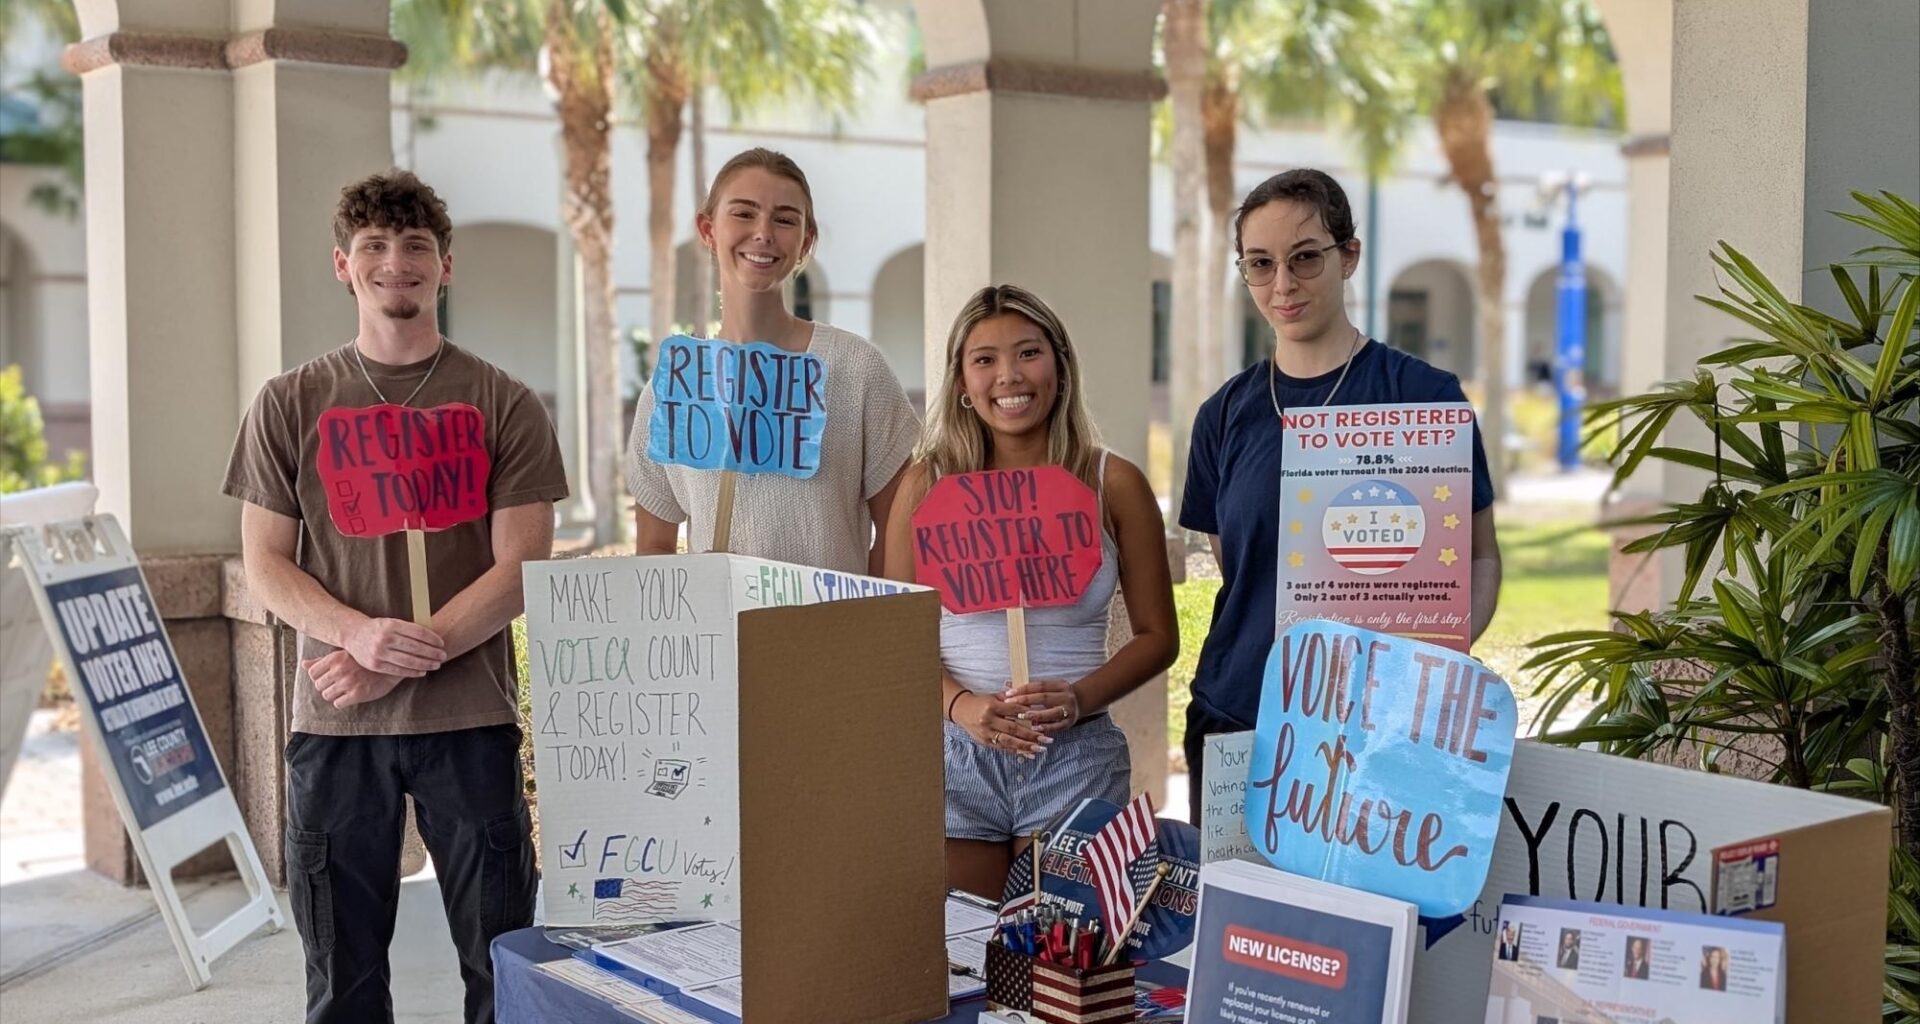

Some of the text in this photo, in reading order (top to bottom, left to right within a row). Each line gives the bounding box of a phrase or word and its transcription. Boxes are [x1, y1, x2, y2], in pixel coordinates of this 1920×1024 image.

[669, 345, 826, 413] REGISTER
[663, 401, 813, 470] TO VOTE
[1282, 409, 1473, 429] NOT REGISTERED
[1299, 429, 1456, 449] TO VOTE YET?
[328, 409, 482, 470] REGISTER
[1356, 454, 1394, 465] 78.8%
[372, 457, 477, 517] TODAY!
[1315, 469, 1338, 477] voter
[1341, 468, 1375, 476] turnout
[1389, 467, 1403, 475] the
[1405, 466, 1430, 474] 2024
[1432, 465, 1472, 474] election.
[957, 470, 1038, 516] STOP!
[1343, 529, 1405, 543] VOTED
[1370, 511, 1378, 524] I
[916, 511, 1094, 565] REGISTER TO
[549, 567, 697, 624] MAKE YOUR
[813, 571, 911, 603] STUDE
[942, 554, 1078, 607] VOTE HERE
[1286, 580, 1460, 590] 3 out of 4 voters were registered.
[1294, 592, 1451, 602] Only 2 out of 3 actually voted.
[57, 584, 156, 654] UPDATE
[1354, 614, 1364, 624] is
[1367, 612, 1392, 628] only
[1396, 612, 1412, 624] the
[1412, 611, 1437, 629] first
[1440, 611, 1470, 628] step!
[81, 639, 174, 703] VOTER INFO
[648, 633, 723, 682] COUNT
[541, 691, 707, 739] & REGISTER
[1283, 632, 1500, 763] VOICE THE
[546, 744, 627, 784] TODAY!
[1214, 741, 1248, 767] Your
[1206, 803, 1222, 818] the
[1253, 722, 1468, 871] future
[600, 834, 678, 875] FGCU
[1052, 835, 1076, 853] LEE
[1504, 797, 1706, 914] YOUR
[1041, 851, 1096, 888] ELECTI
[1229, 935, 1341, 977] NEW LICENSE?
[1222, 997, 1254, 1012] replaced
[1254, 1006, 1270, 1016] your
[1271, 1007, 1297, 1023] license
[1257, 991, 1286, 1009] recently
[1287, 1000, 1320, 1016] renewed
[1321, 1009, 1331, 1018] or
